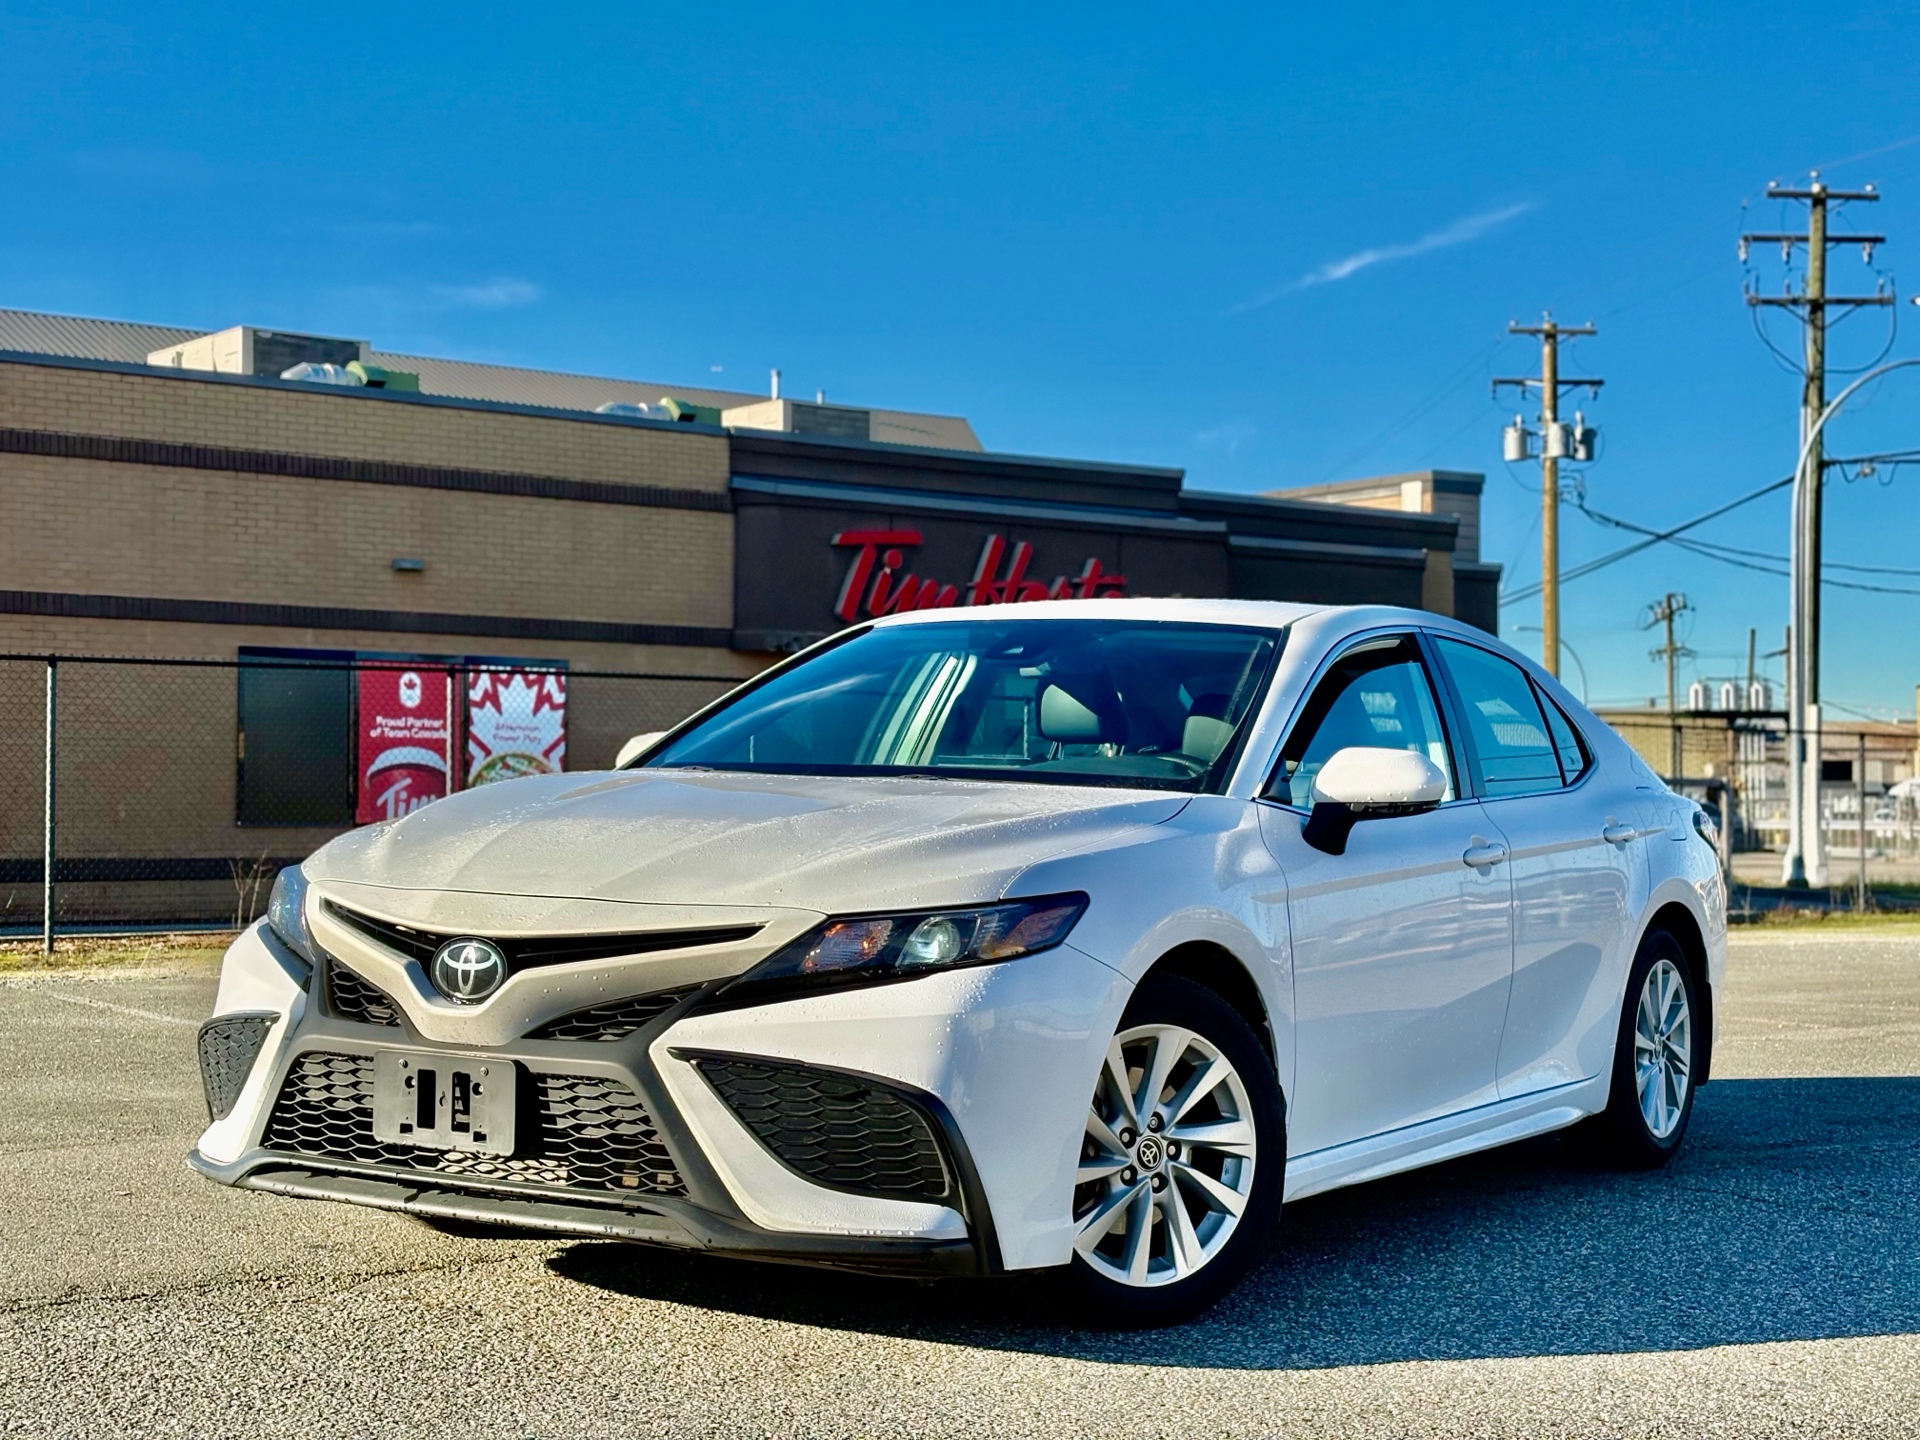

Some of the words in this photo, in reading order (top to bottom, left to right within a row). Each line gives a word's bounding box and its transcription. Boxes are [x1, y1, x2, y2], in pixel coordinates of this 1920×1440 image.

[831, 530, 958, 622] Tim
[376, 716, 405, 727] Proud
[407, 716, 444, 728] Partner
[369, 727, 382, 738] of
[382, 727, 410, 738] Team
